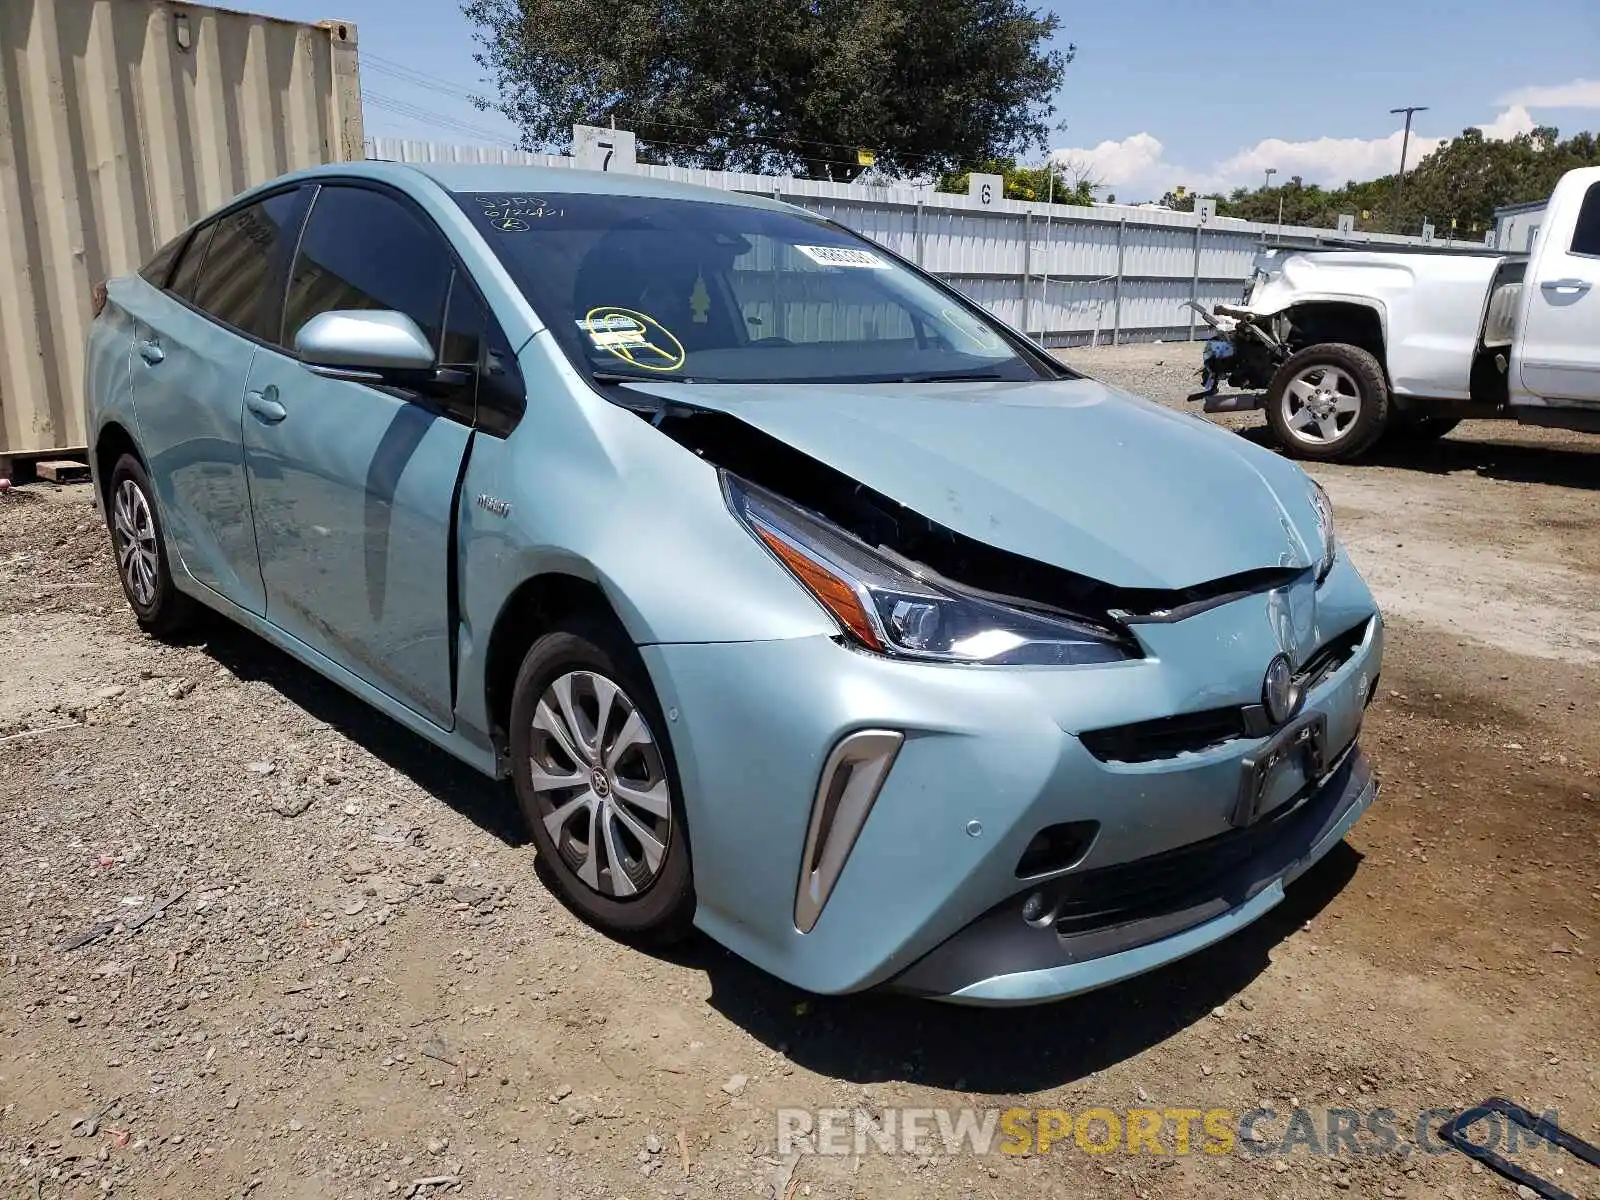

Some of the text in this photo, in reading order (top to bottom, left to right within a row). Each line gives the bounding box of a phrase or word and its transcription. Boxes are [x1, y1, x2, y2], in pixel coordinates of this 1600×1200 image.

[597, 142, 613, 171] 7
[981, 184, 991, 205] 6
[1201, 207, 1208, 223] 5
